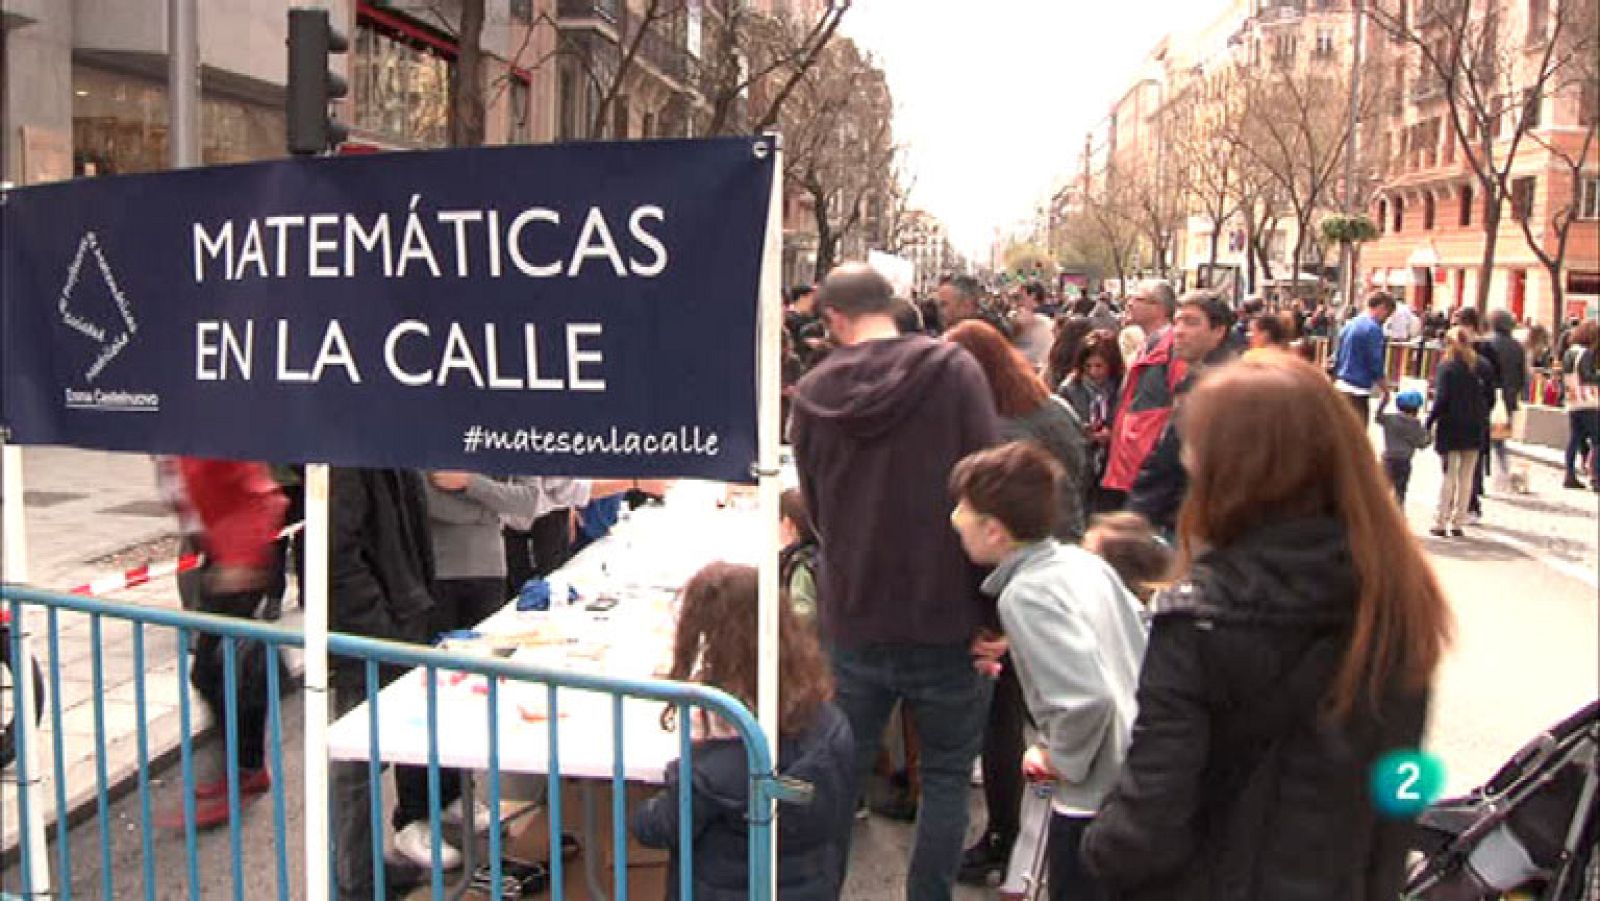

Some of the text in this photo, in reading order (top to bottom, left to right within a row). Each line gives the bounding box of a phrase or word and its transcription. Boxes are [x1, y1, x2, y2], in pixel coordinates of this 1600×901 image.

[193, 193, 668, 282] MATEMÁTICAS
[196, 318, 253, 381] EN
[276, 318, 361, 383] LA
[384, 320, 606, 391] CALLE
[463, 425, 719, 457] #matesenlacalle
